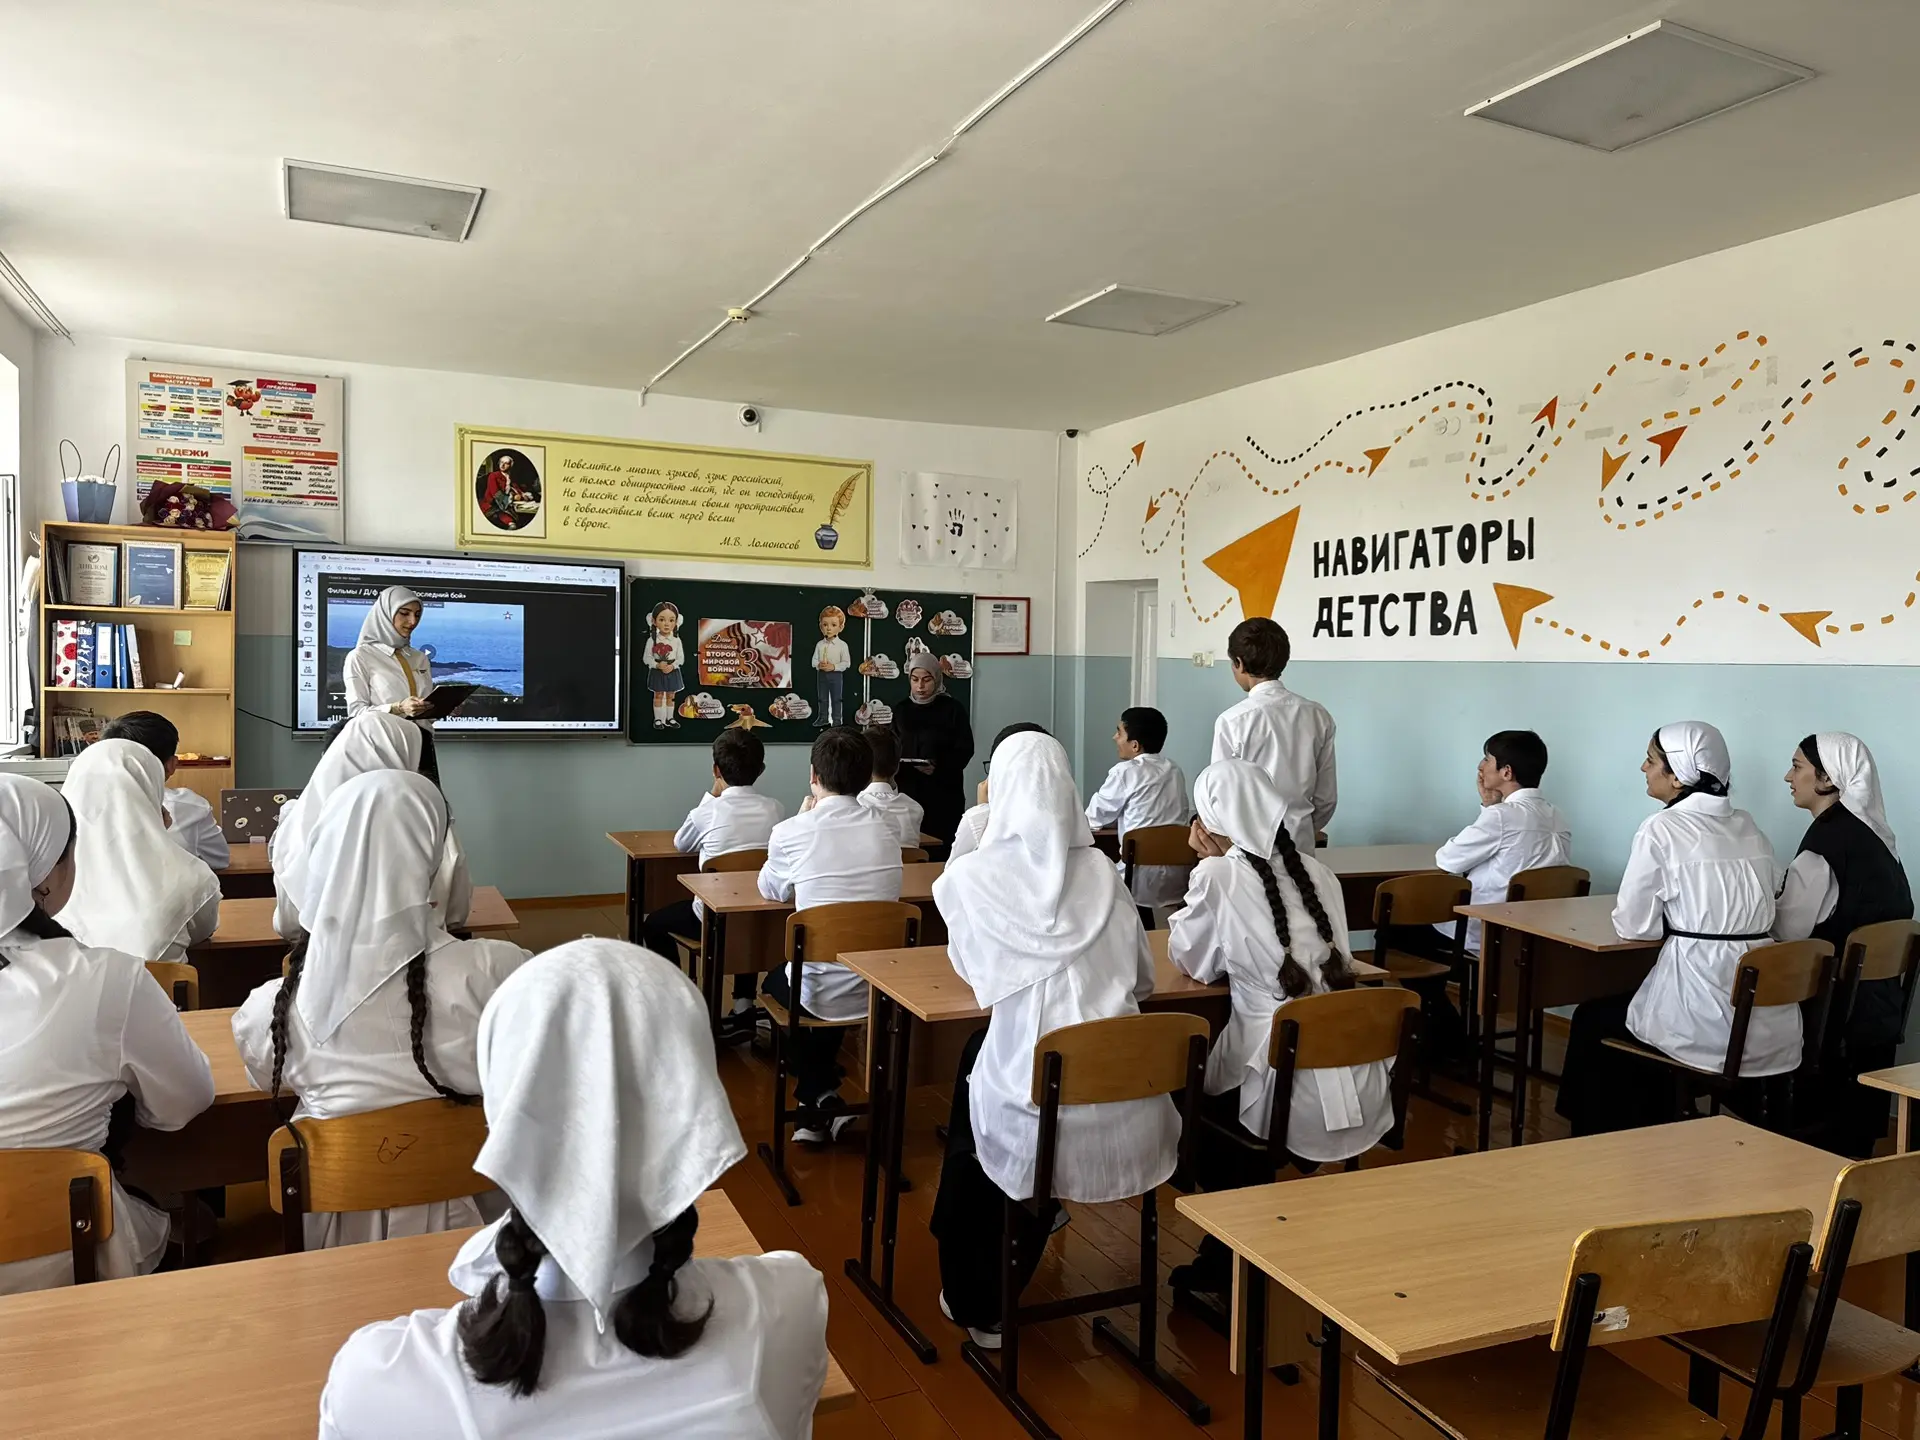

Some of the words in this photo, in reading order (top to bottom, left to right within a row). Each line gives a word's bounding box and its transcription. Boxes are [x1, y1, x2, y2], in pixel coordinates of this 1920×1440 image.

[156, 447, 209, 458] ПАДЕЖИ
[562, 458, 622, 473] Повелитель
[626, 466, 662, 476] многих
[666, 468, 700, 480] языков,
[705, 472, 728, 484] язык
[730, 474, 784, 487] российский,
[562, 488, 576, 498] Но
[581, 488, 618, 501] вместе
[634, 492, 697, 506] собственным
[702, 498, 730, 508] своим
[734, 503, 804, 515] пространством
[580, 476, 616, 486] только
[620, 476, 686, 492] обширностью
[690, 486, 717, 496] мест,
[723, 486, 735, 495] где
[755, 489, 815, 504] господствует,
[563, 516, 569, 526] в
[574, 516, 611, 532] Европе.
[574, 502, 643, 517] довольствием
[648, 508, 674, 519] велик
[680, 511, 704, 524] перед
[708, 512, 735, 523] всеми
[720, 537, 742, 547] М.В.
[748, 538, 800, 550] Ломоносов
[1313, 516, 1534, 578] НАВИГАТОРЫ
[327, 587, 358, 595] Фильмы
[363, 589, 378, 597] Д/ф
[1312, 589, 1478, 638] ДЕТСТВА
[711, 634, 731, 643] День
[736, 648, 759, 678] 3
